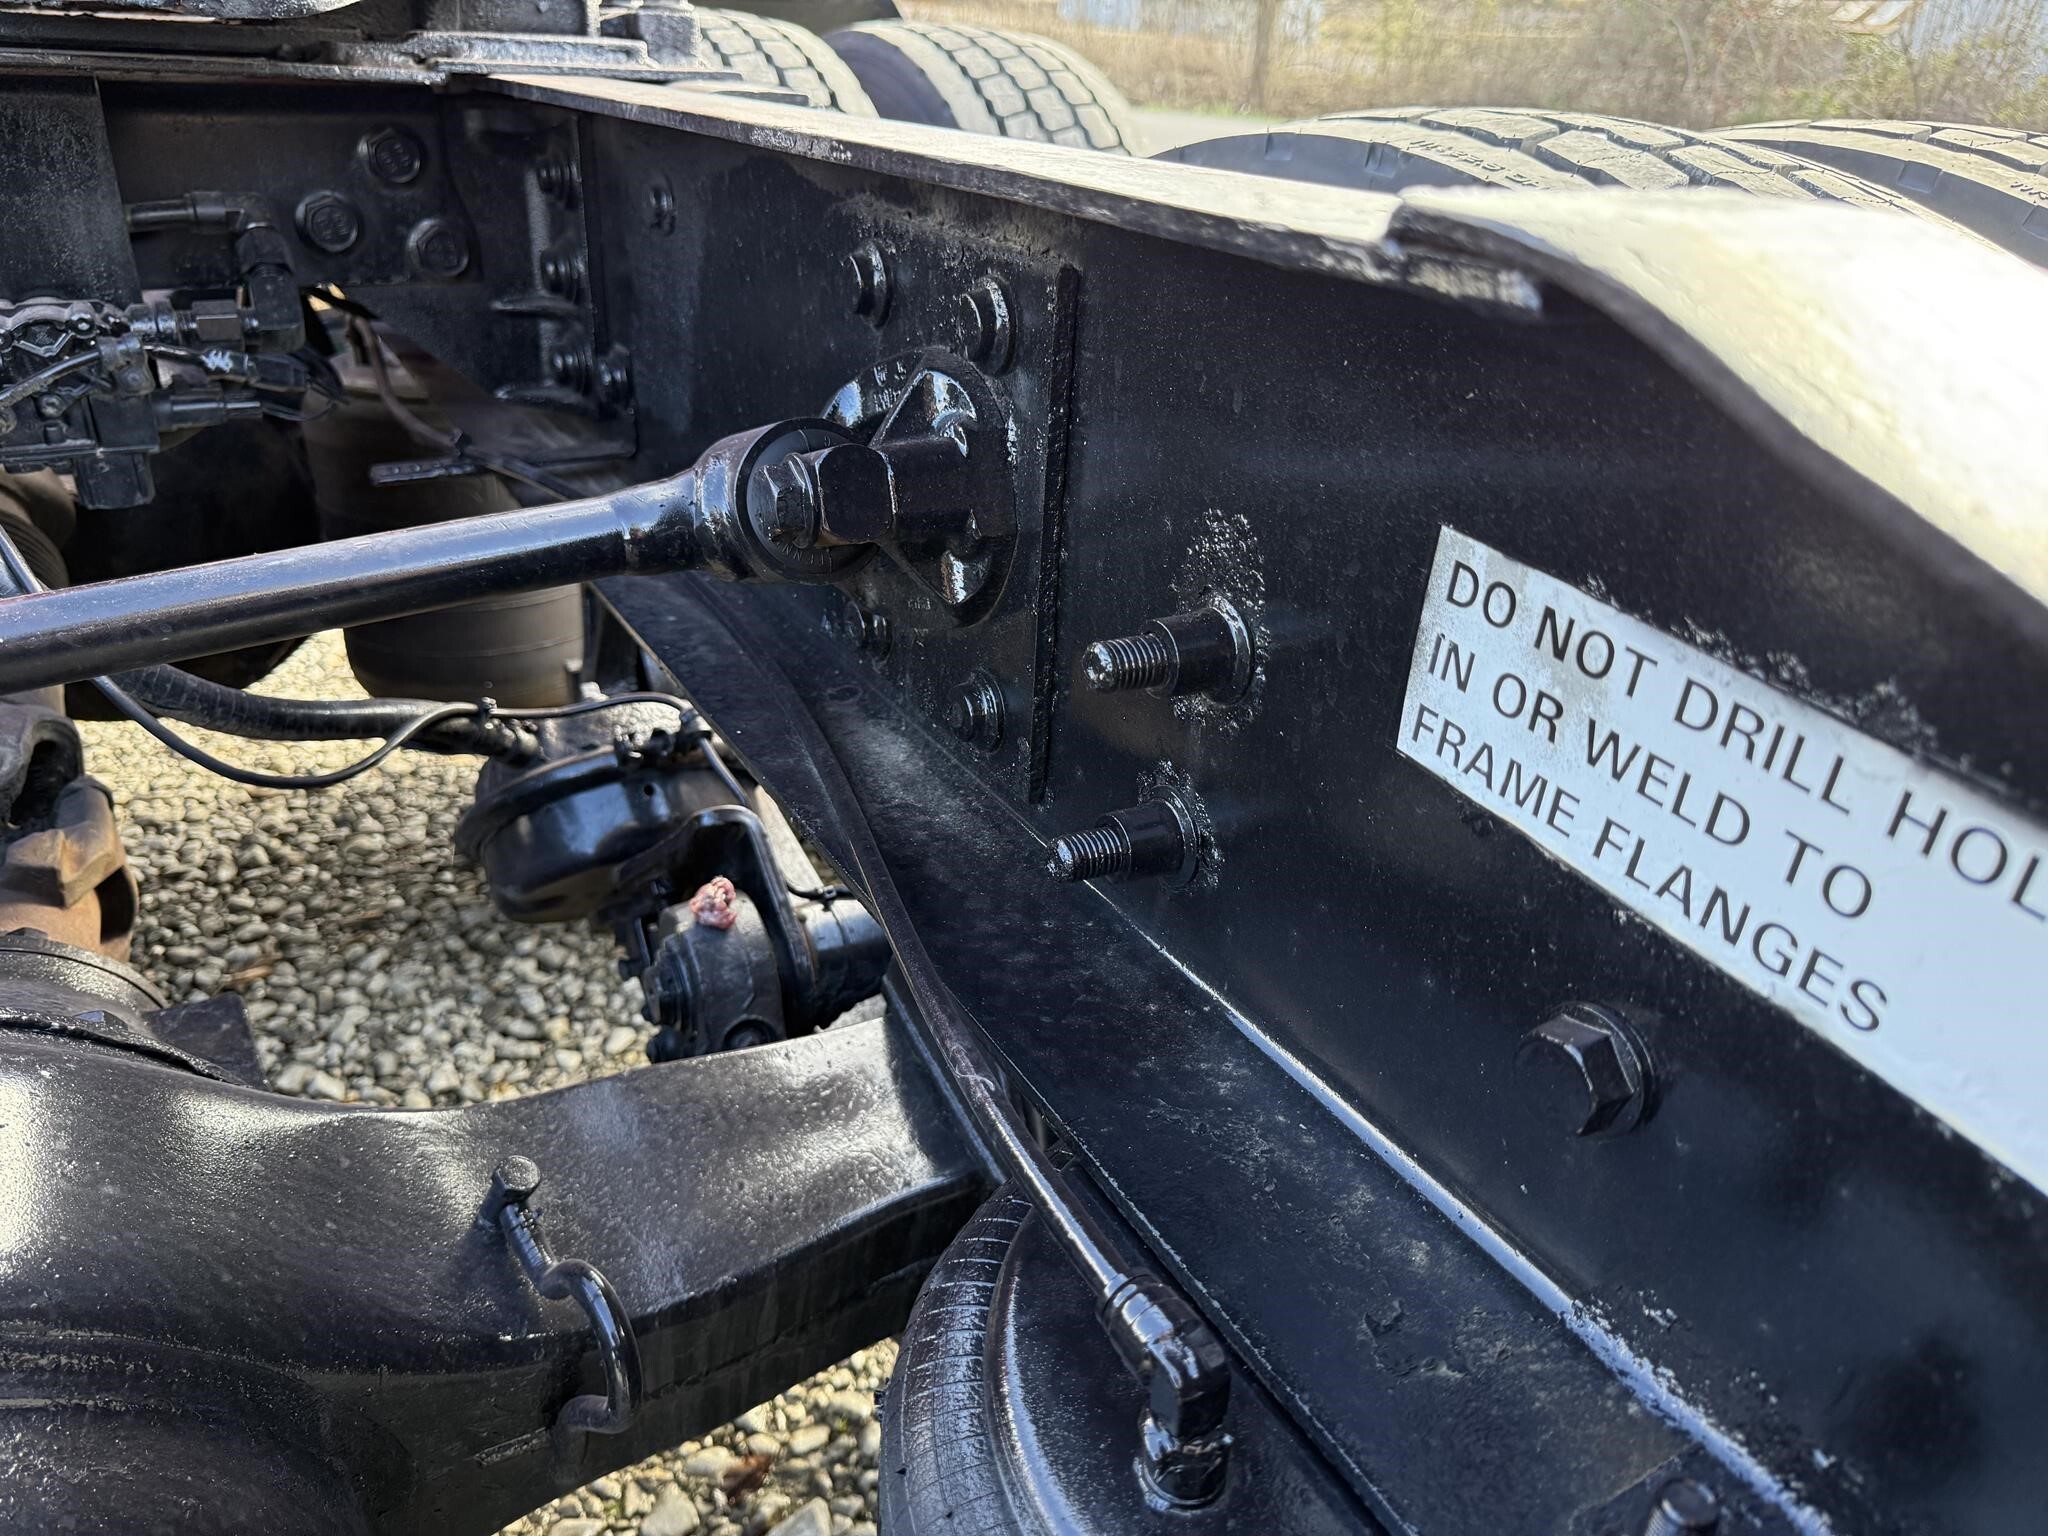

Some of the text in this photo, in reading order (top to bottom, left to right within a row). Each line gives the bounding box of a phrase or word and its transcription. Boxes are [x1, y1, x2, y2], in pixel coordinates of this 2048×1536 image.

[1411, 702, 1888, 1033] FRAME FLANGES
[1427, 633, 1873, 920] IN OR WELD TO
[1446, 558, 2047, 922] DO NOT DRILL HOL
